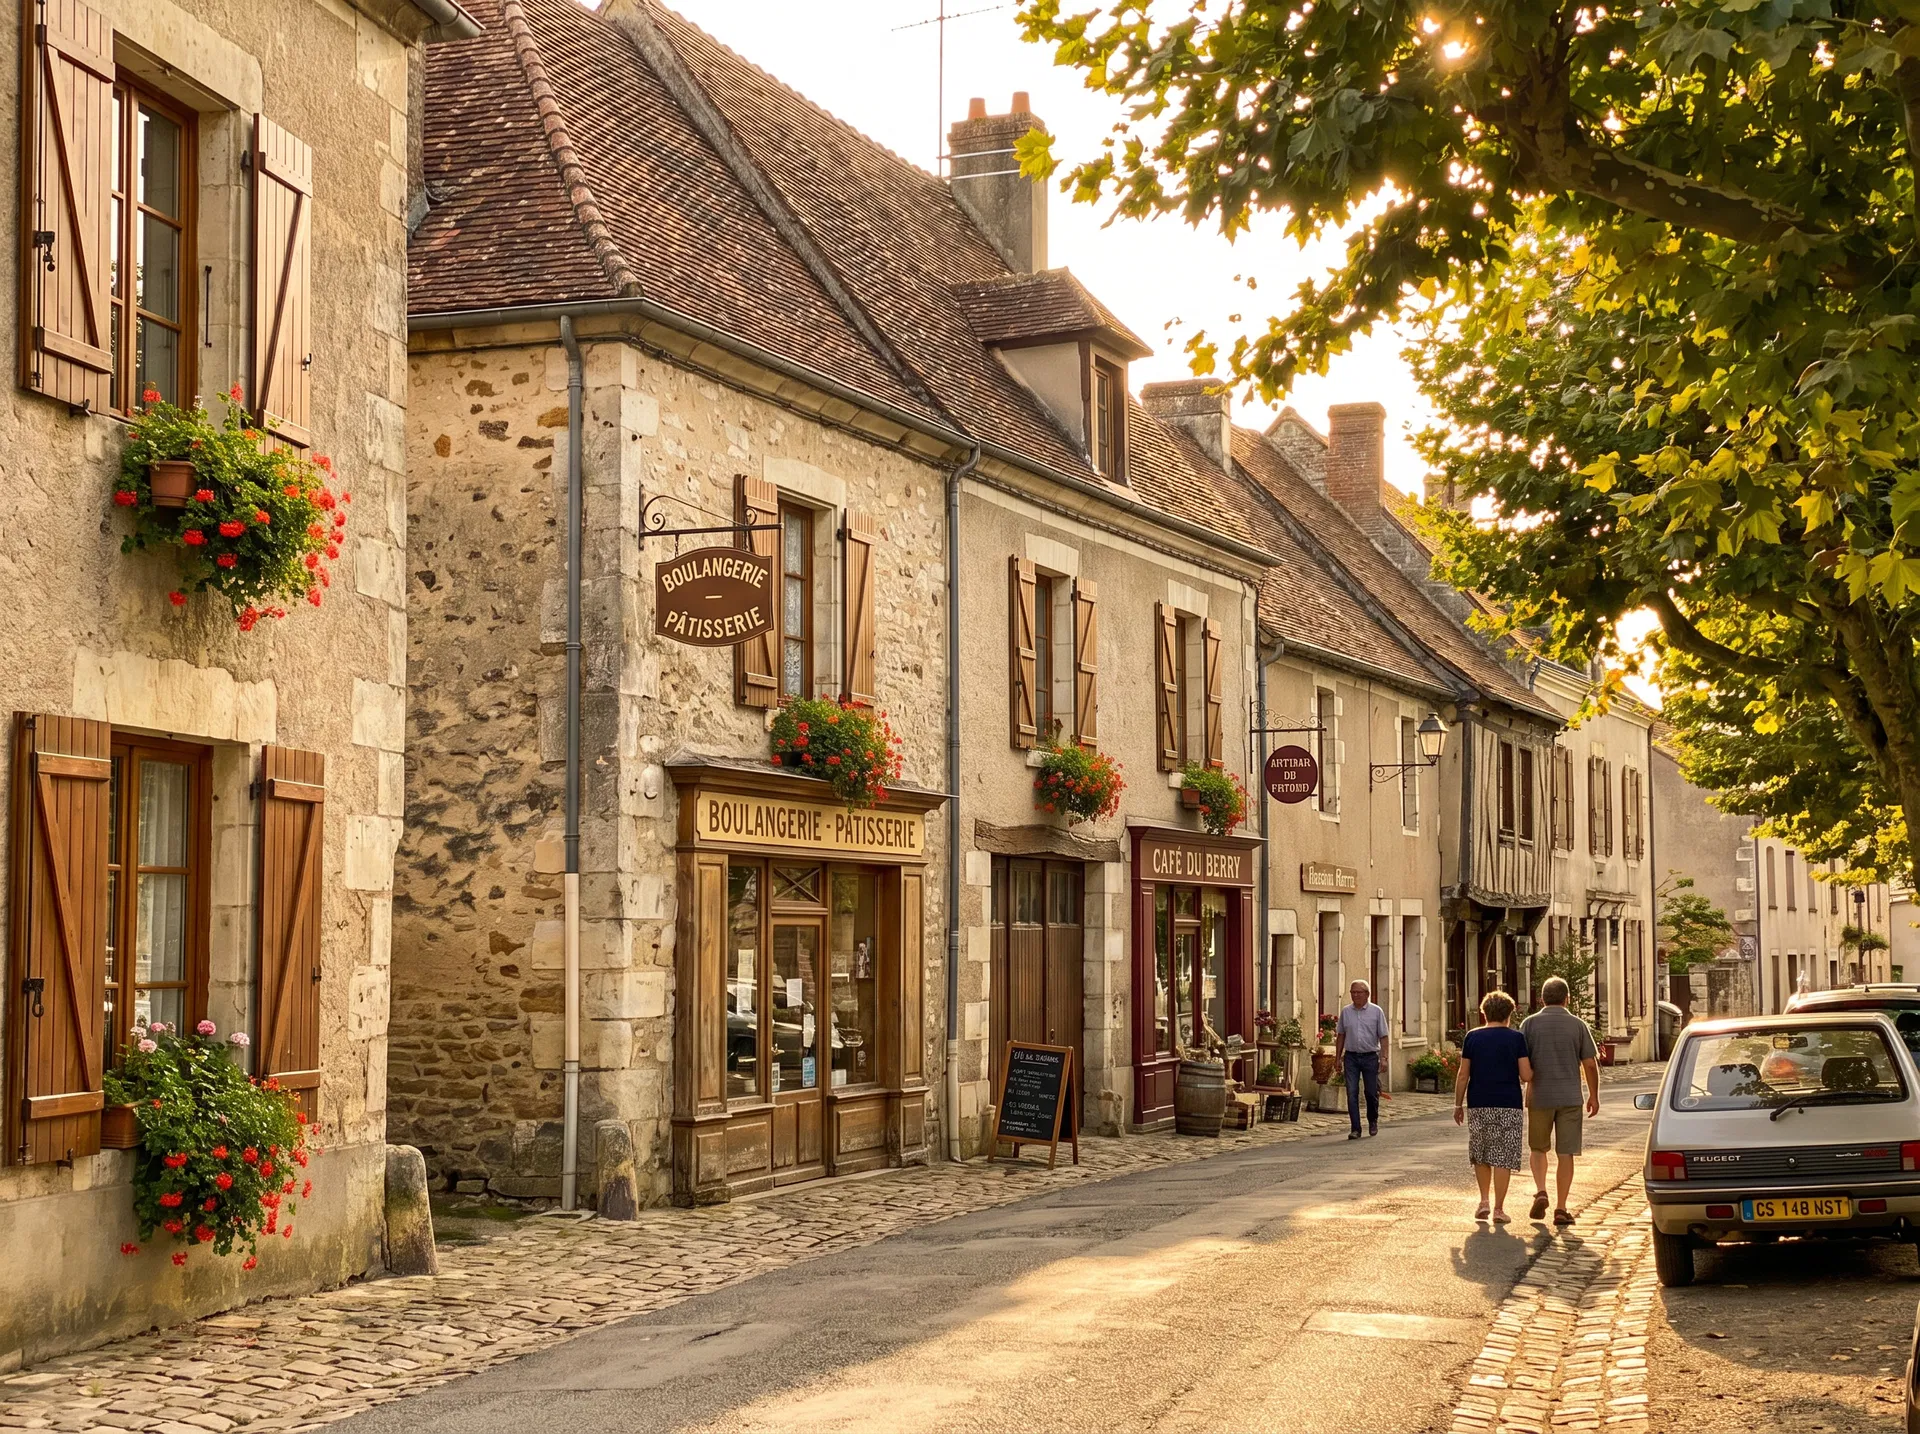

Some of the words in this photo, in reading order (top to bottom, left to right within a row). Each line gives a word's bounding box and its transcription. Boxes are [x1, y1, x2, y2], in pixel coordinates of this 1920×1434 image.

[661, 557, 769, 593] BOULANGERIE
[664, 606, 765, 638] PÂTISSERIE
[709, 800, 822, 842] BOULANGERIE
[1153, 845, 1182, 875] CAFÉ
[1187, 851, 1201, 876] DU
[1206, 853, 1241, 879] BERRY
[1756, 1201, 1774, 1217] CS
[1814, 1199, 1843, 1215] NST
